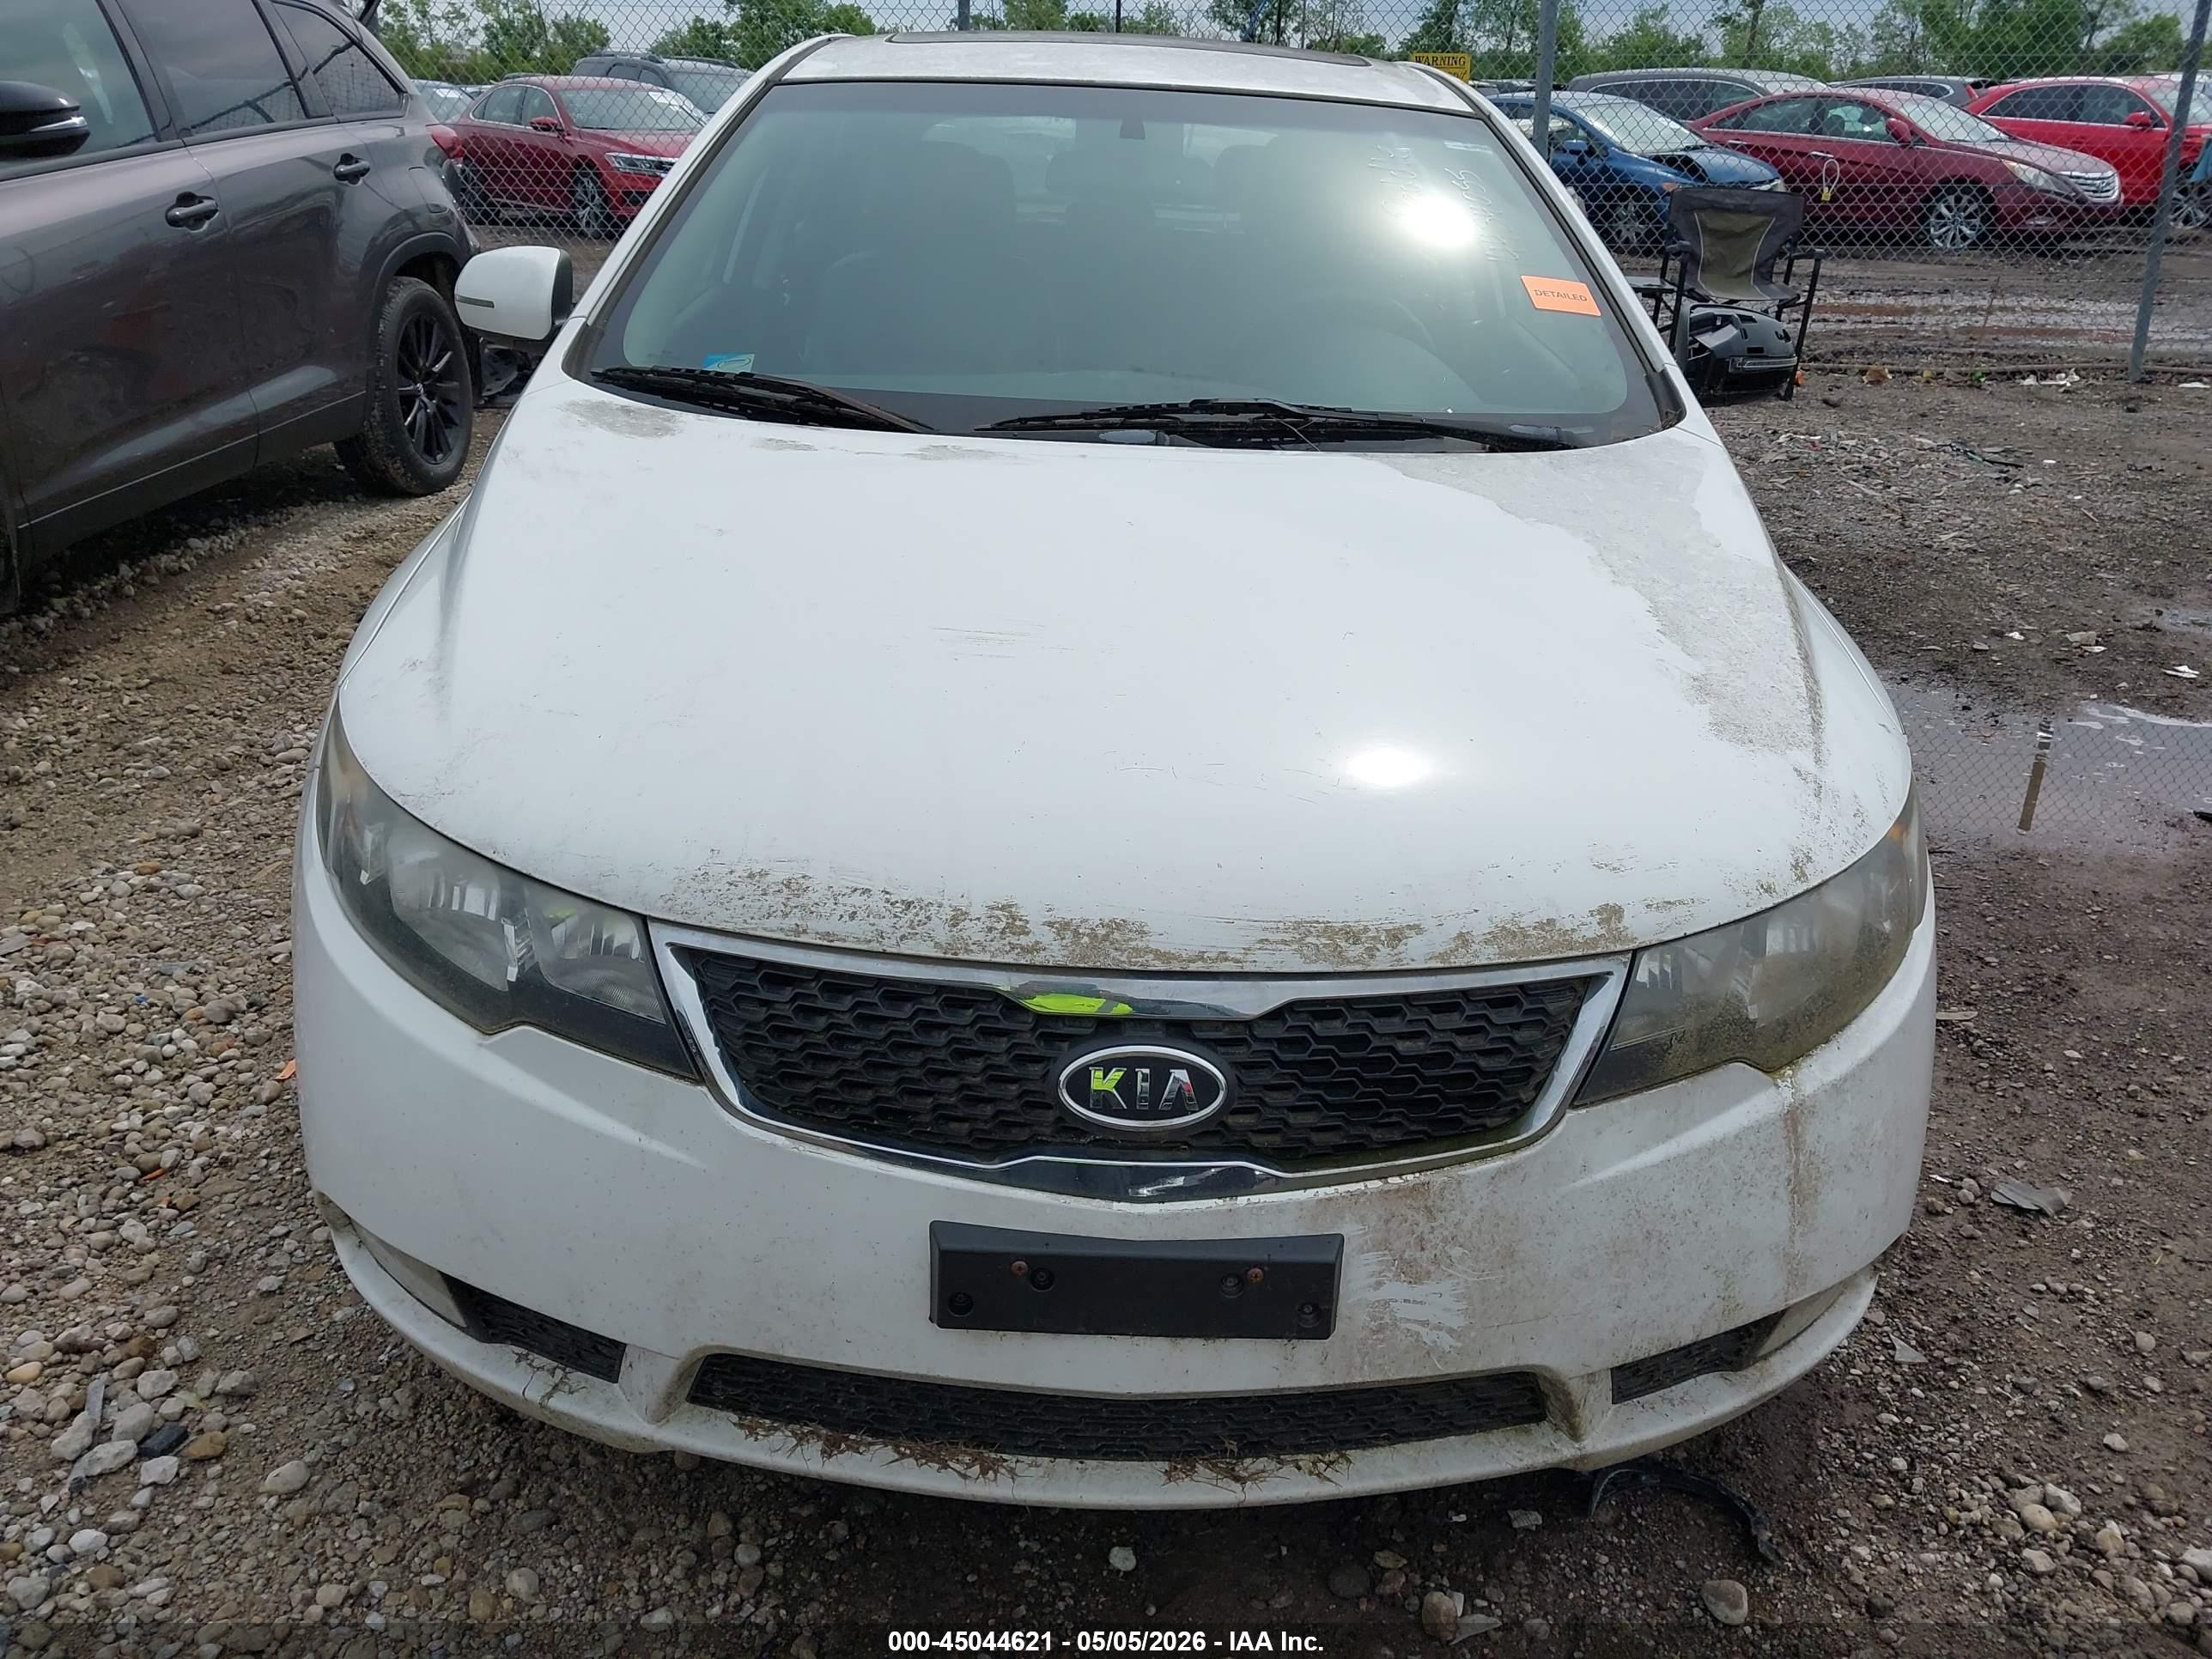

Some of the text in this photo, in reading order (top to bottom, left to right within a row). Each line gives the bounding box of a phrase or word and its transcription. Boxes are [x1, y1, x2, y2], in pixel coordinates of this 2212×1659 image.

[1415, 55, 1467, 66] WARNING
[1533, 289, 1588, 302] DETAILED
[1088, 1066, 1200, 1111] KIA
